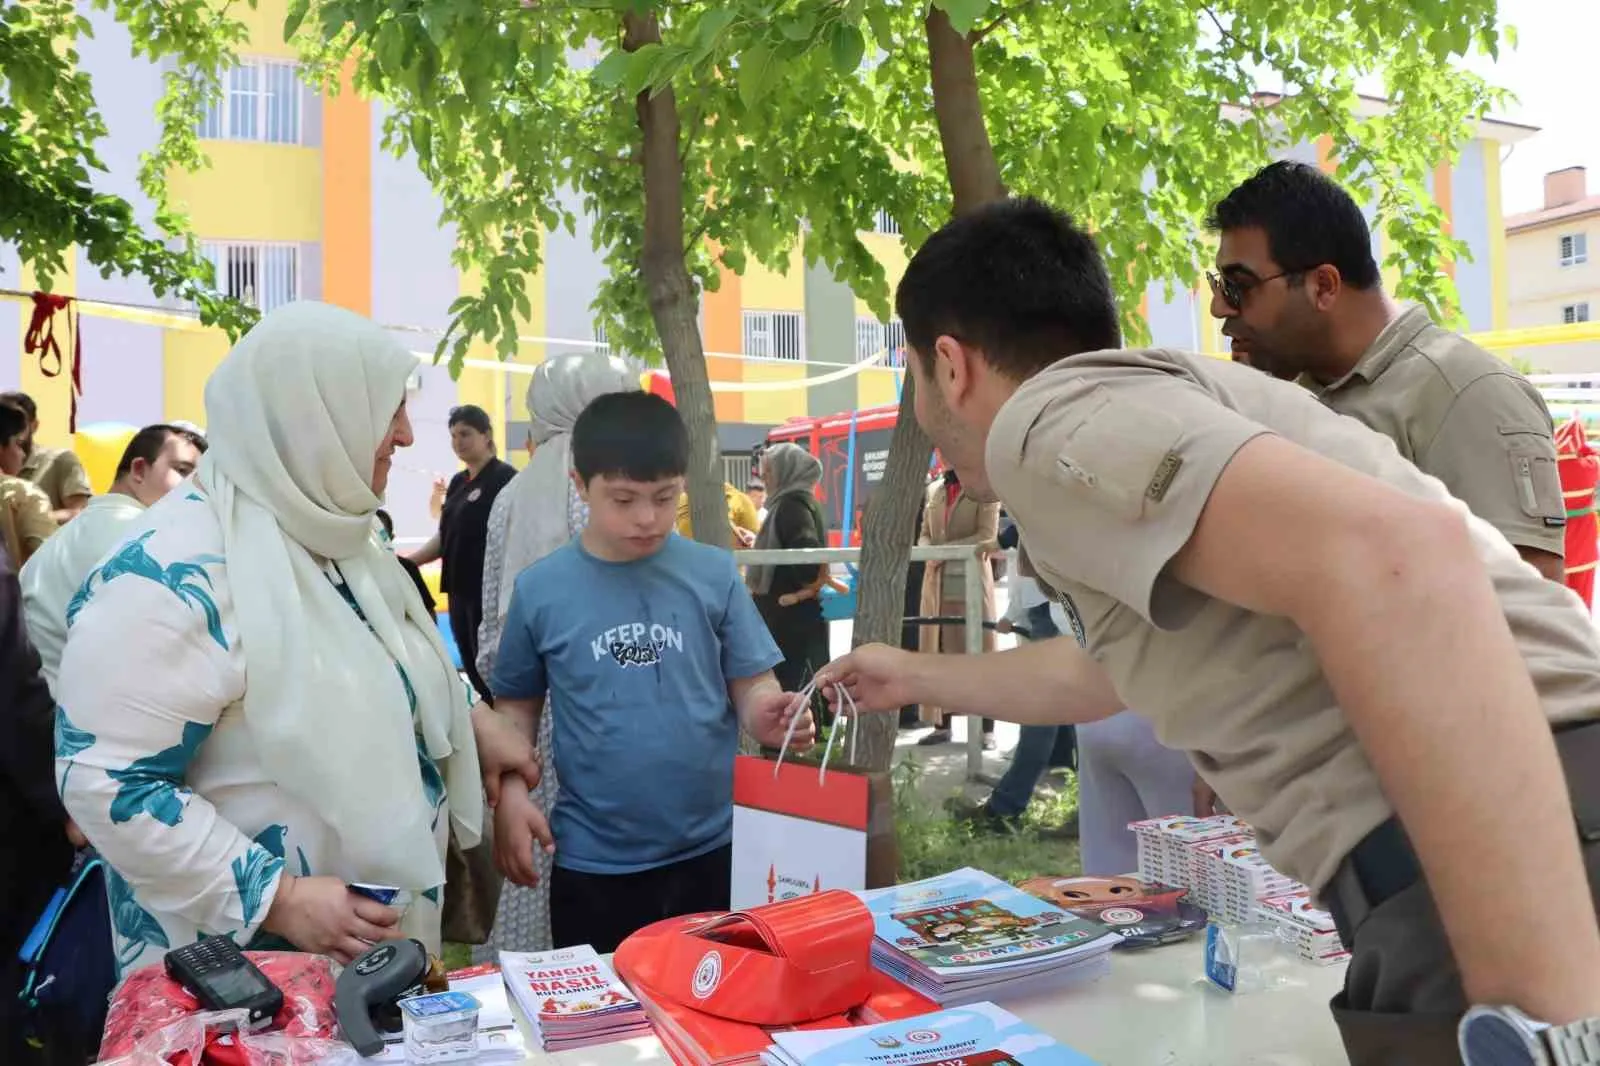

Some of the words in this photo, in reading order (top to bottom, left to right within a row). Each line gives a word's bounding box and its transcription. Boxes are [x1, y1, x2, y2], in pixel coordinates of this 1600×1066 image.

[591, 622, 645, 662] KEEP
[649, 623, 684, 653] ON
[525, 964, 597, 979] YANGIN
[530, 975, 608, 991] NASIL
